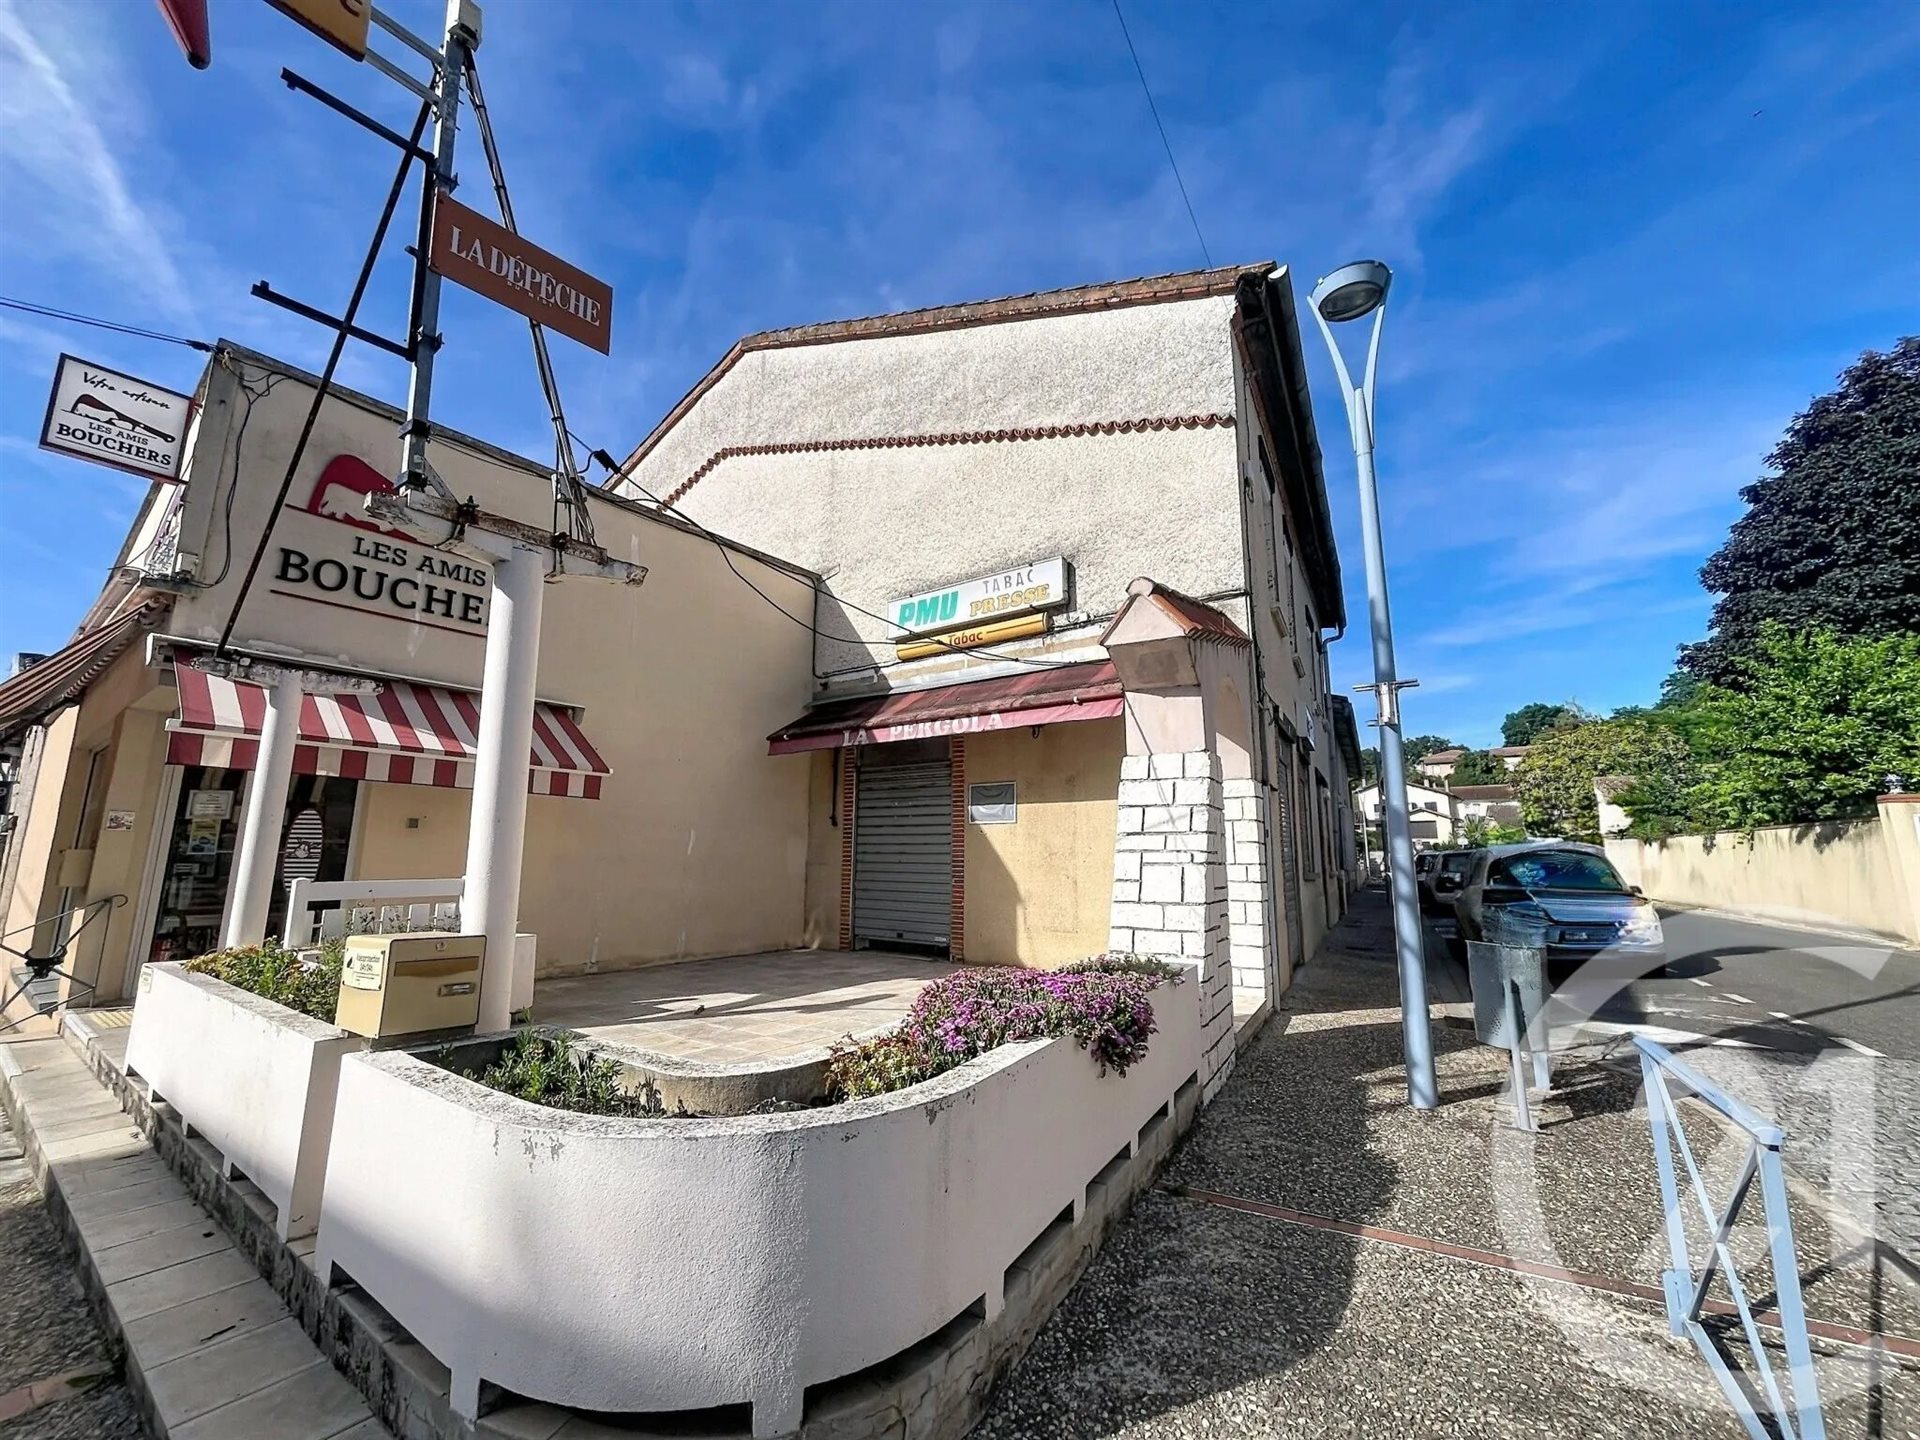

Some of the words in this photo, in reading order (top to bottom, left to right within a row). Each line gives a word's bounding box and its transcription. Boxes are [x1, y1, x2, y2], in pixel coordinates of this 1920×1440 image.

[450, 225, 486, 269] LA
[83, 371, 117, 391] Votre
[122, 389, 171, 409] artisan
[56, 423, 172, 466] BOUCHERS
[89, 422, 112, 435] LES
[116, 430, 149, 446] AMIS
[353, 536, 407, 567] LES
[416, 555, 487, 587] AMIS
[983, 569, 1034, 594] TABAC
[275, 547, 488, 625] BOUCHE
[898, 590, 958, 627] PMU
[970, 584, 1050, 617] PRESSE
[948, 631, 983, 646] Tabac
[842, 728, 869, 746] LA
[888, 713, 1004, 740] PERGOLA
